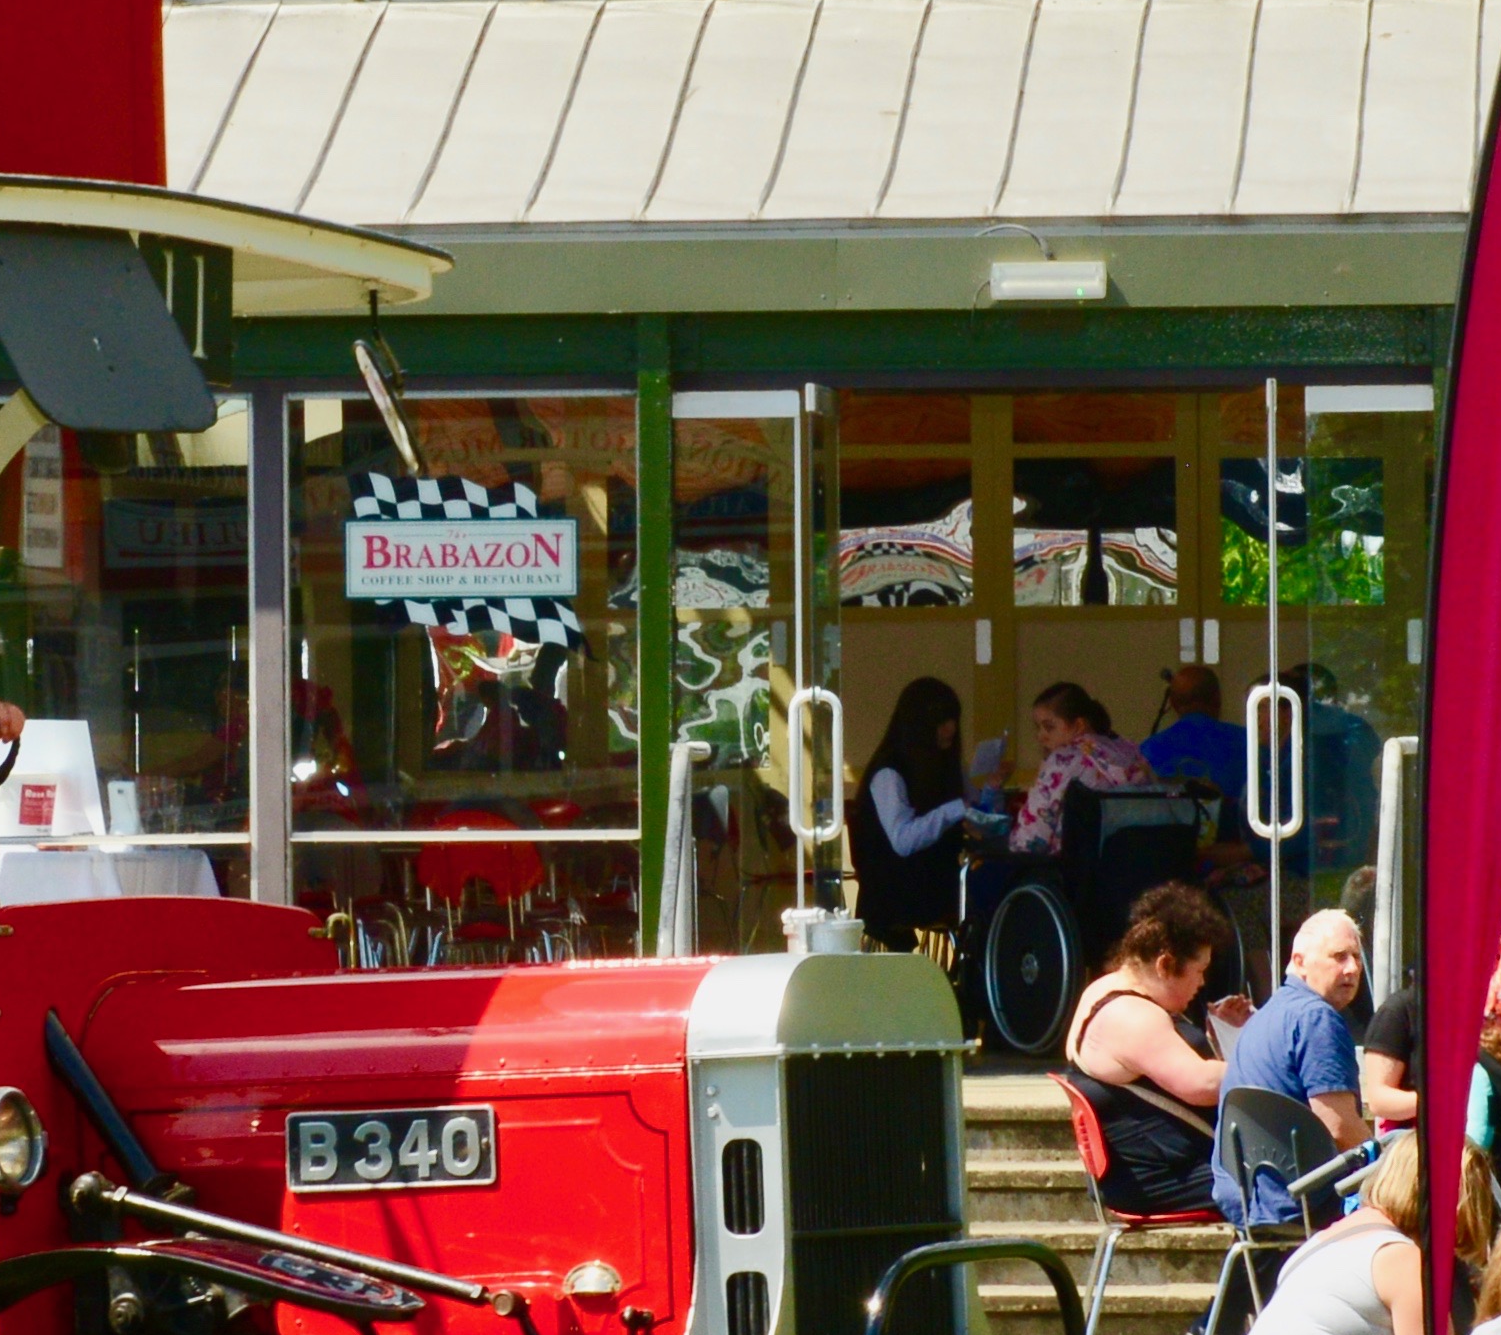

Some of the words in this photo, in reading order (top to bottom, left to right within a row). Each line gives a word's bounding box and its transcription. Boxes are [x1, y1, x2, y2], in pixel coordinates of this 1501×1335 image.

[362, 533, 563, 570] BRABAZON
[361, 574, 412, 586] COFFEE
[418, 574, 454, 585] SHOP
[458, 574, 468, 585] &
[474, 573, 562, 585] RESTAURANT
